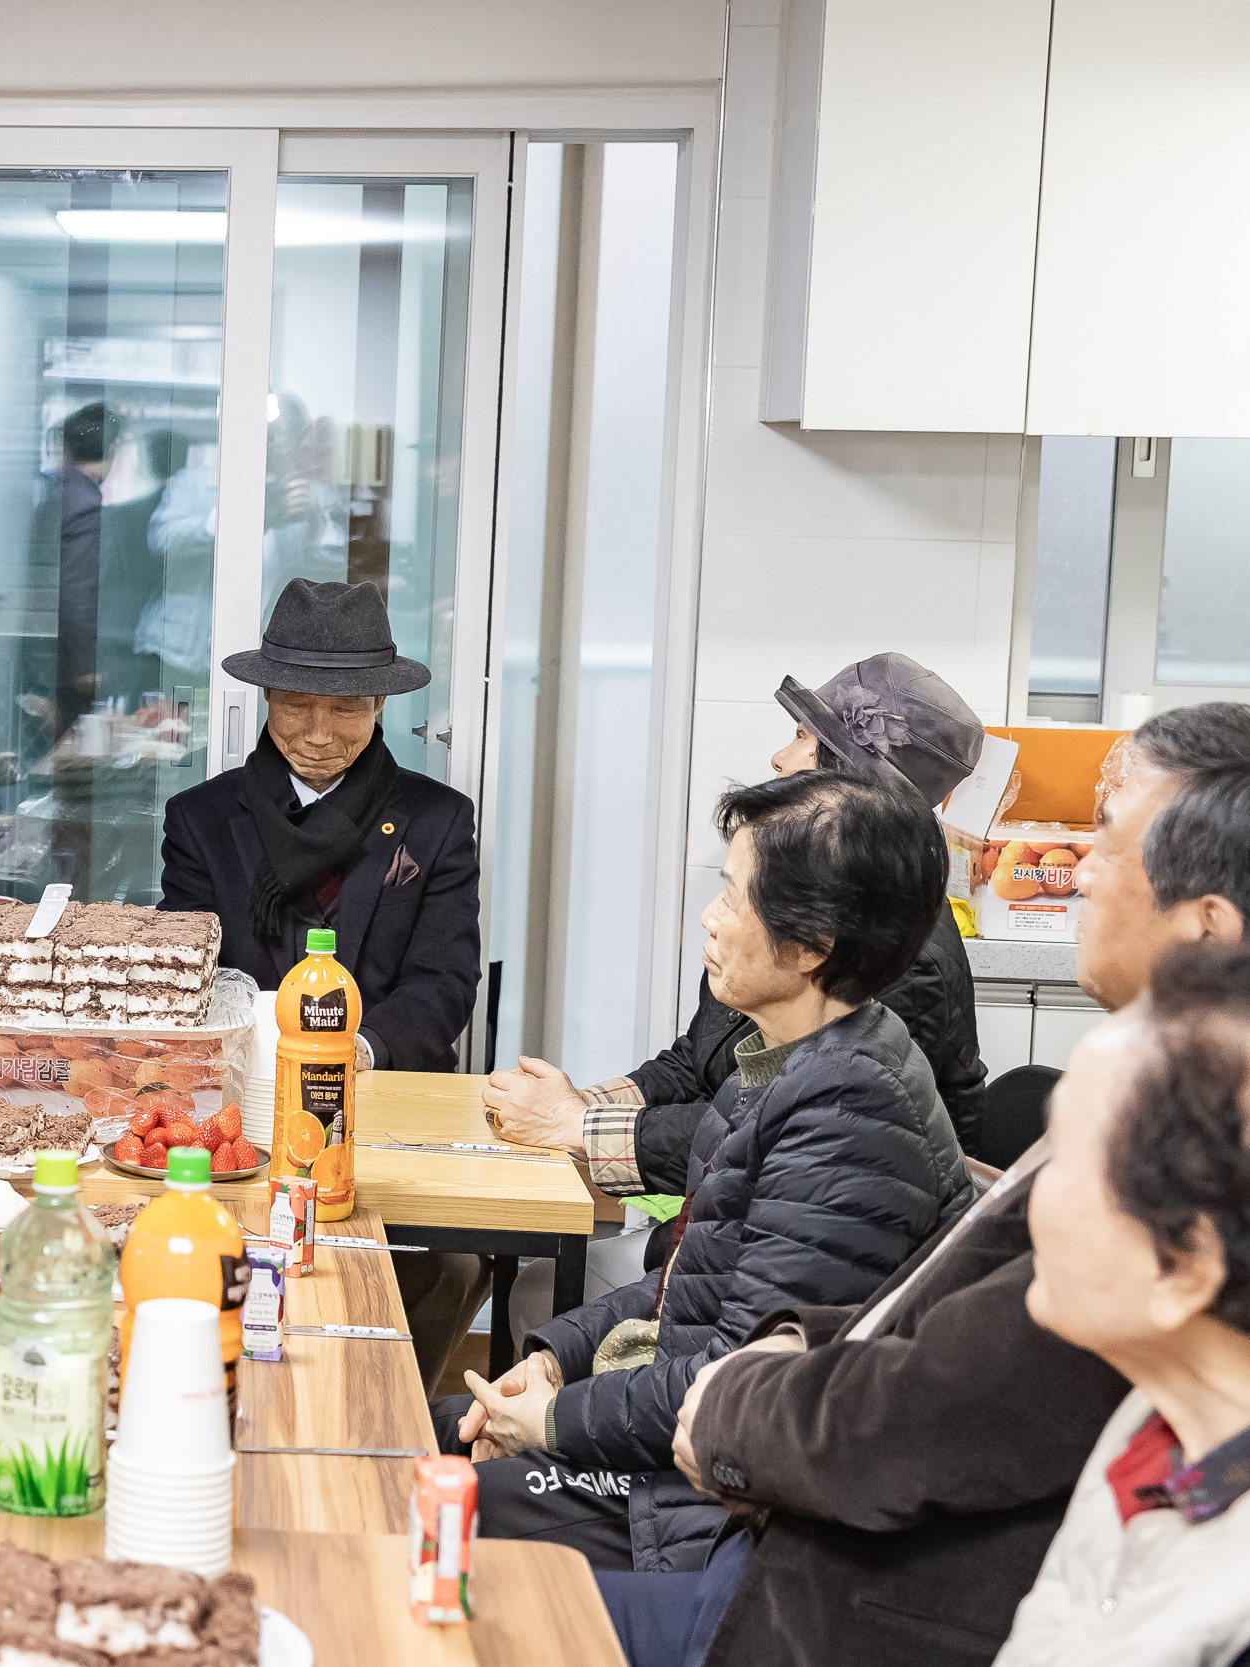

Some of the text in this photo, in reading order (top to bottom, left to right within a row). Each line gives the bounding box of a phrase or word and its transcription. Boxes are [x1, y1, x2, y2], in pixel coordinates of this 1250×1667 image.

[1012, 868, 1045, 881] 진시황
[303, 1005, 344, 1017] Minute
[309, 1016, 339, 1027] Maid
[525, 1466, 562, 1494] FC
